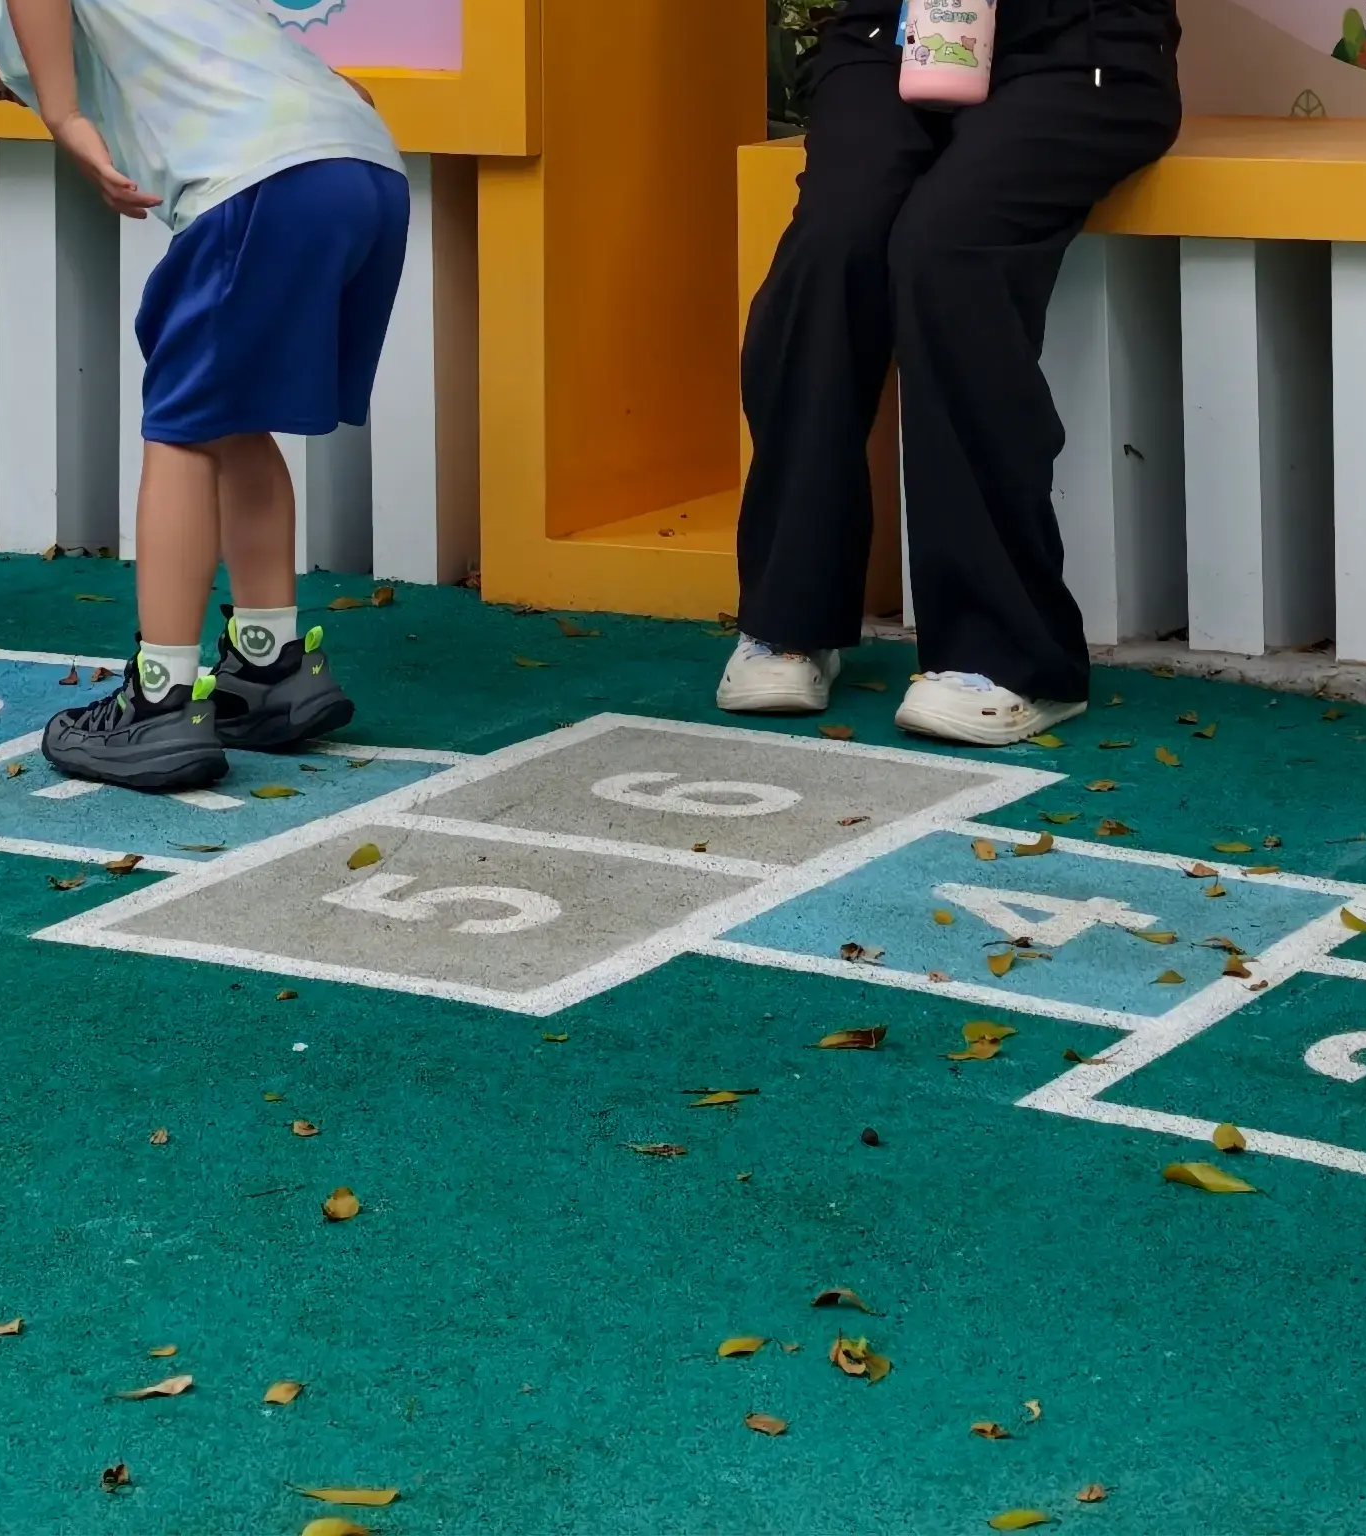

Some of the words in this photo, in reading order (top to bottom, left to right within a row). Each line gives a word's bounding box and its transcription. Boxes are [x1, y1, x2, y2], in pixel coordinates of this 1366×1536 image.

[590, 770, 803, 818] 6
[321, 872, 563, 935] 5
[932, 882, 1161, 948] 4
